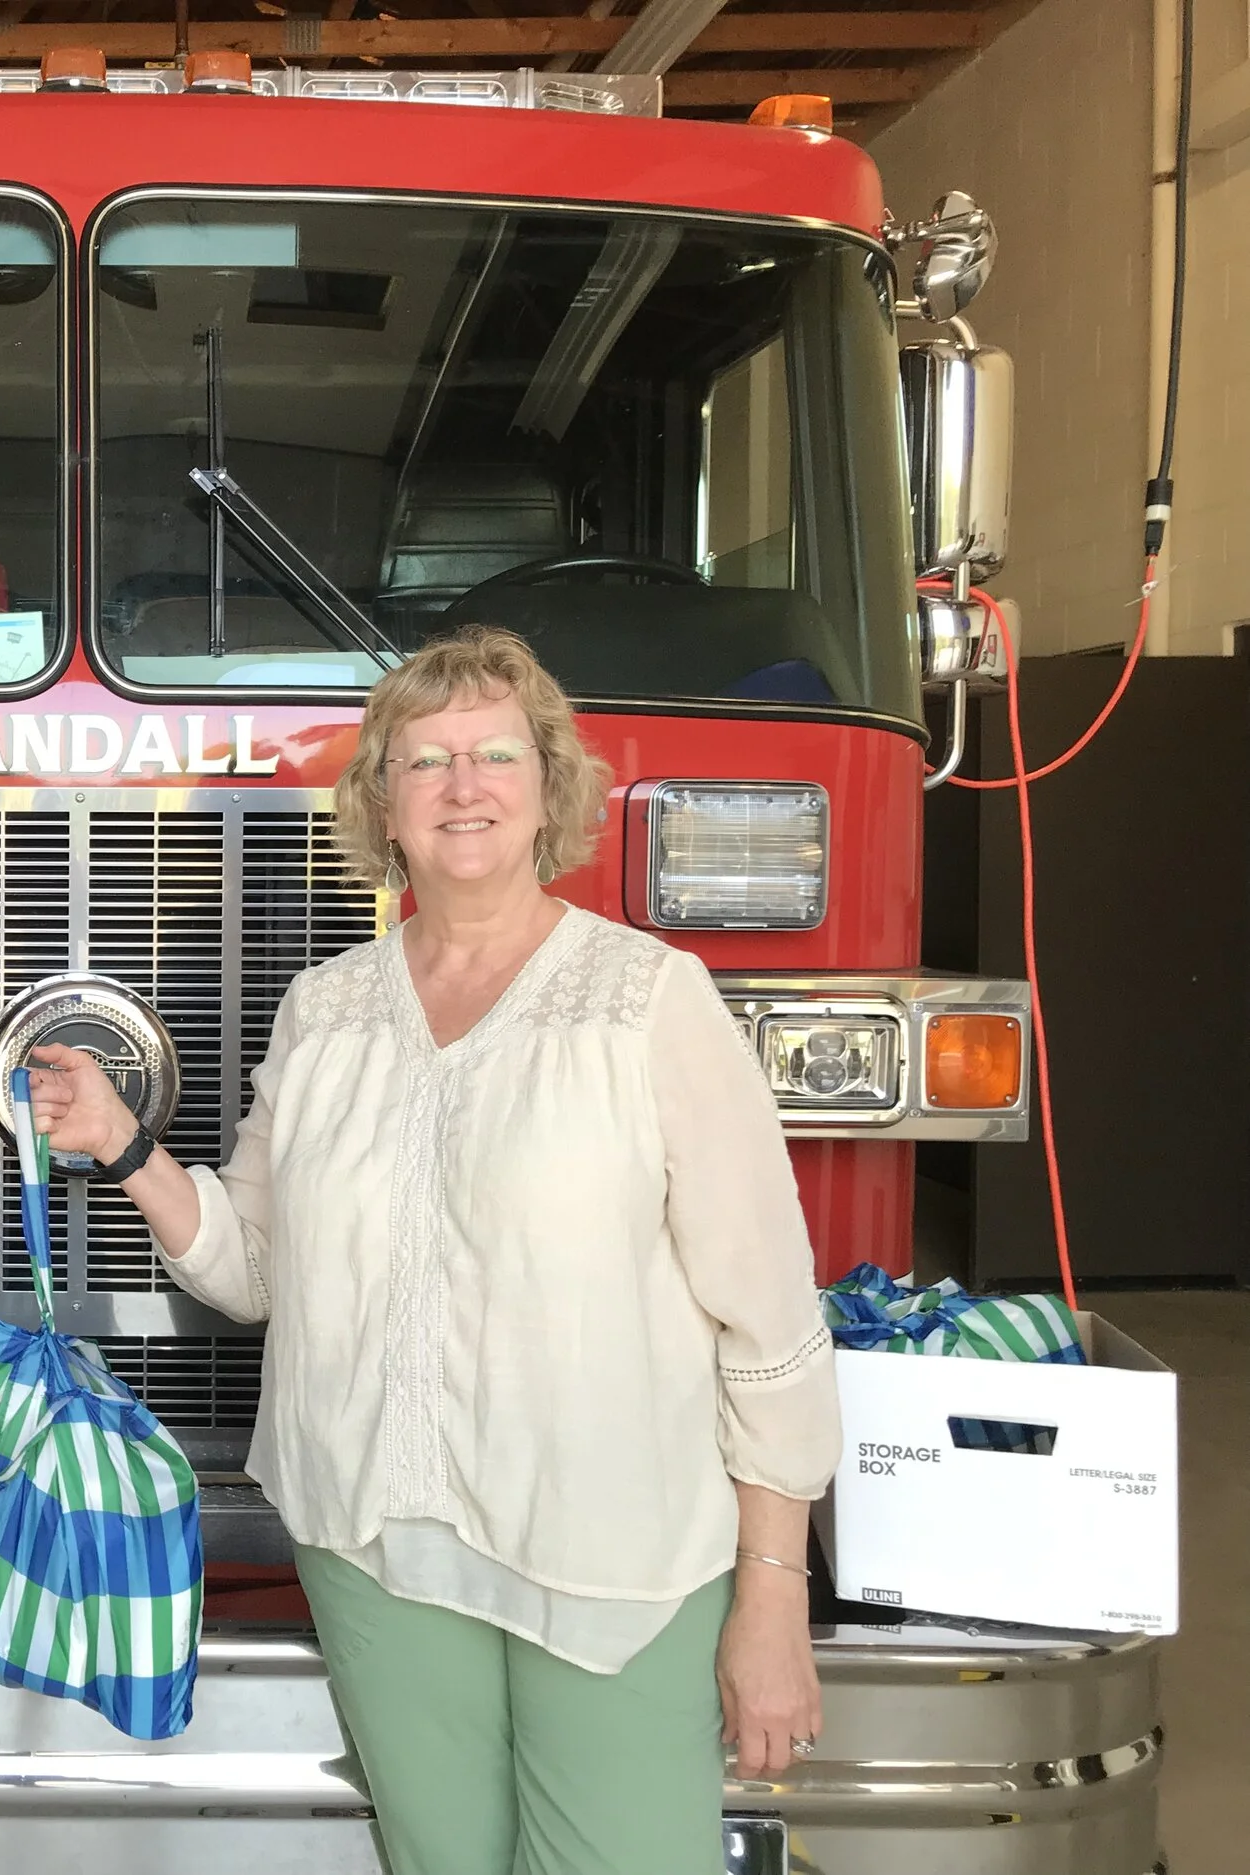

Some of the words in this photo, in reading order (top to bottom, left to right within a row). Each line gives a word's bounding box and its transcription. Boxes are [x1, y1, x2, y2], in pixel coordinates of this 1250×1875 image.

[858, 1442, 941, 1463] STORAGE
[859, 1459, 896, 1476] BOX
[1069, 1467, 1135, 1481] LETTER/LEGAL
[1137, 1473, 1157, 1482] SIZE
[1113, 1483, 1157, 1496] S-3887
[863, 1588, 900, 1603] ULINE
